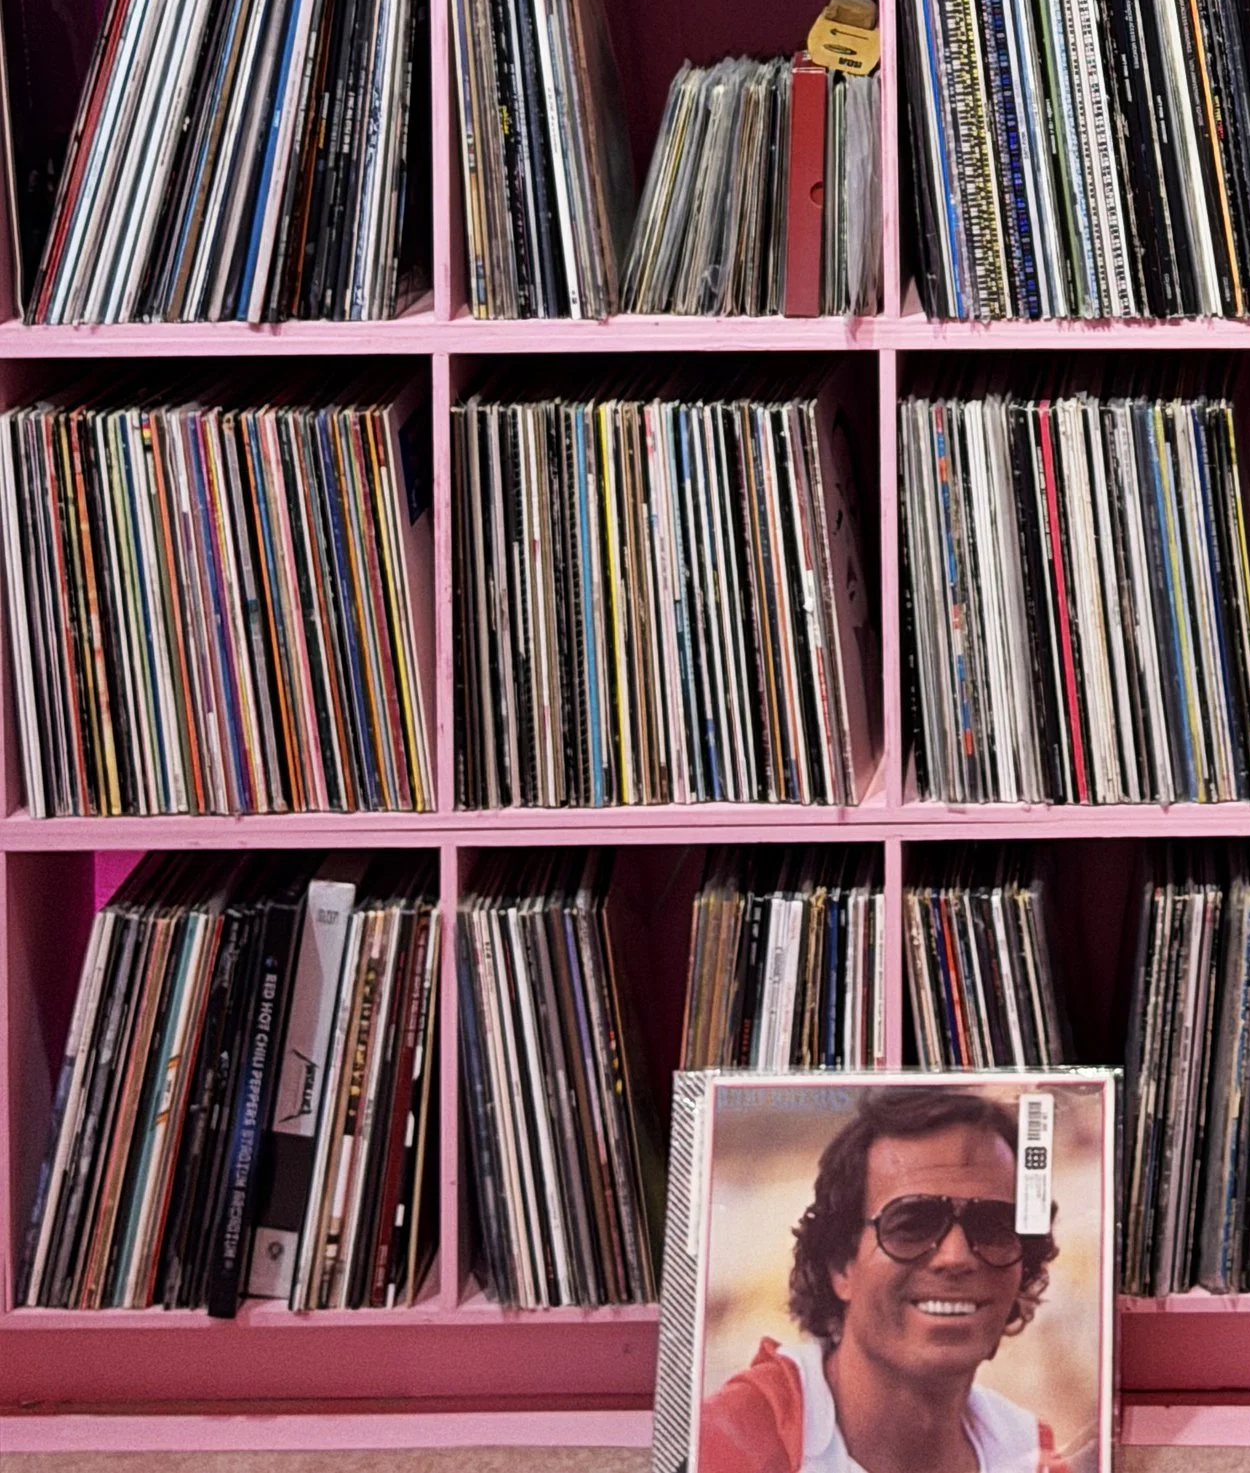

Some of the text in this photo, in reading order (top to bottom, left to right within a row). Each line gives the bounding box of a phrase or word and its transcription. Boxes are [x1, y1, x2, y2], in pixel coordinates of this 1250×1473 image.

[262, 973, 277, 999] RED
[258, 1002, 273, 1032] HOT
[252, 1033, 269, 1068] CHILI
[243, 1069, 263, 1127] PEPPERS
